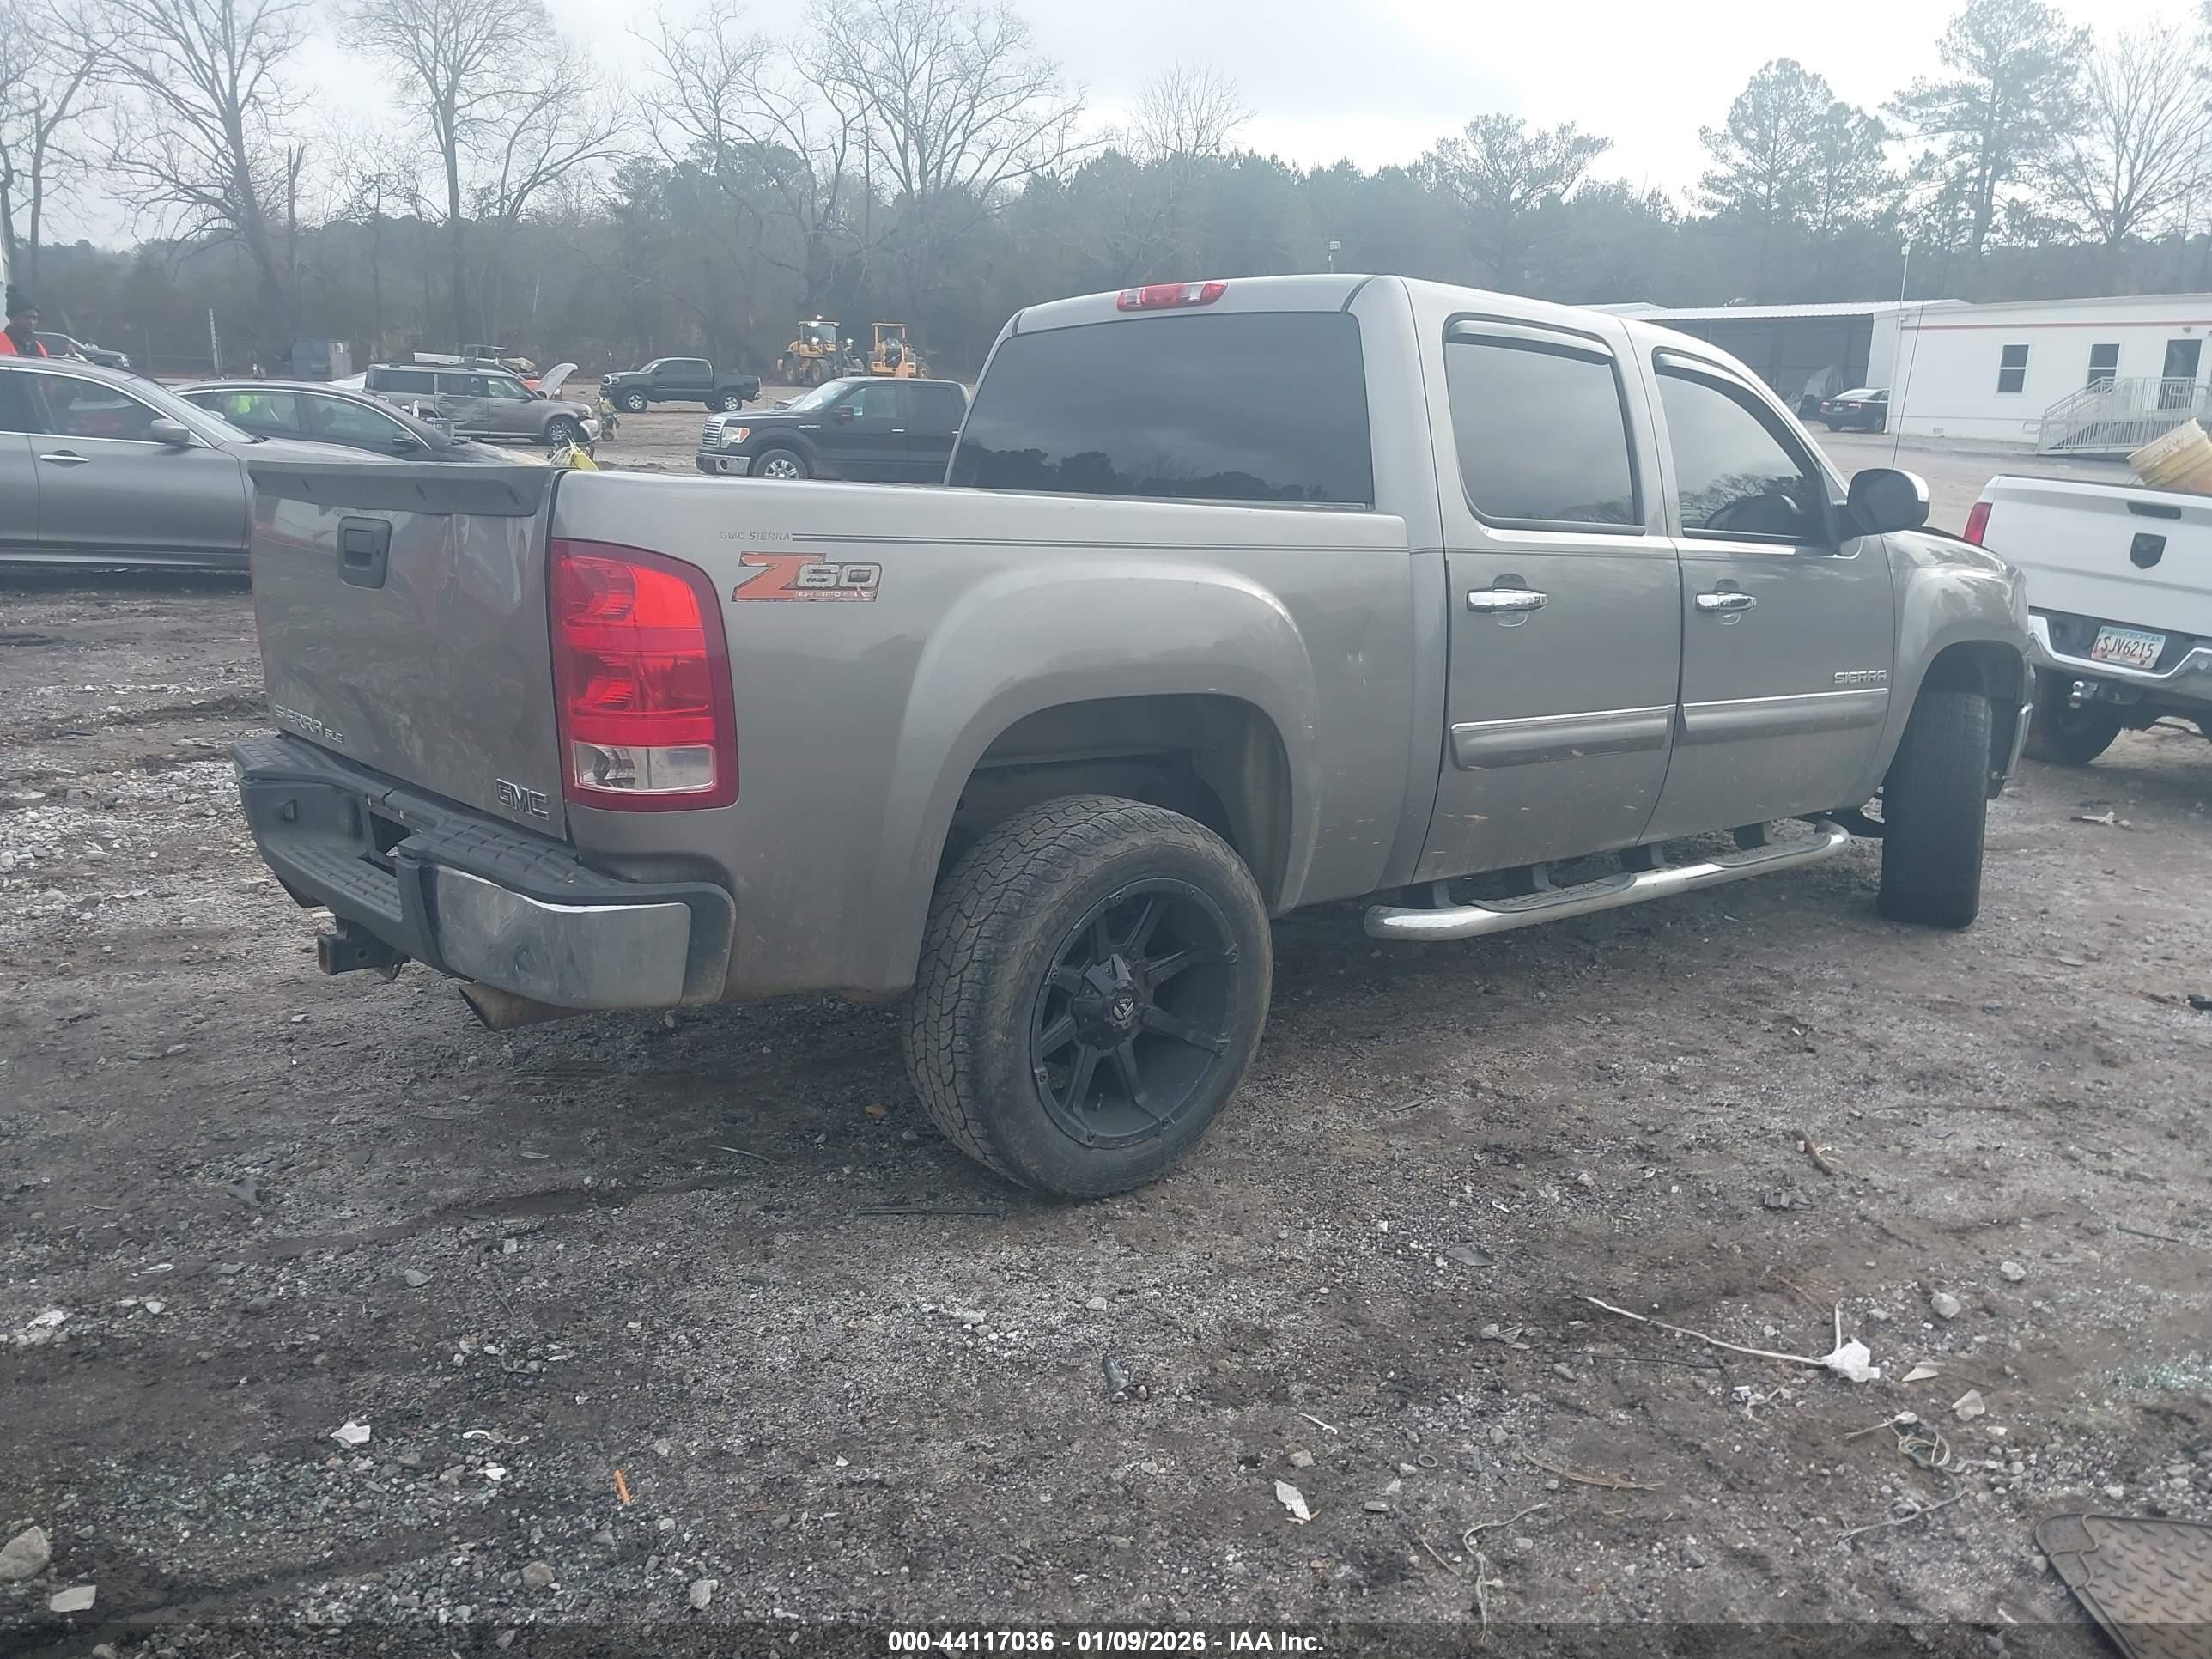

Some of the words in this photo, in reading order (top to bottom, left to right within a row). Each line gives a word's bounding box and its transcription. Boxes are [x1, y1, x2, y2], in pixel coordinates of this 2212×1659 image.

[720, 531, 745, 540] GMC
[748, 532, 790, 541] SIERRA
[2100, 635, 2155, 659] SJV6215
[1834, 670, 1887, 684] SIERRA
[275, 704, 323, 734] SIERRA
[495, 778, 550, 821] GMC
